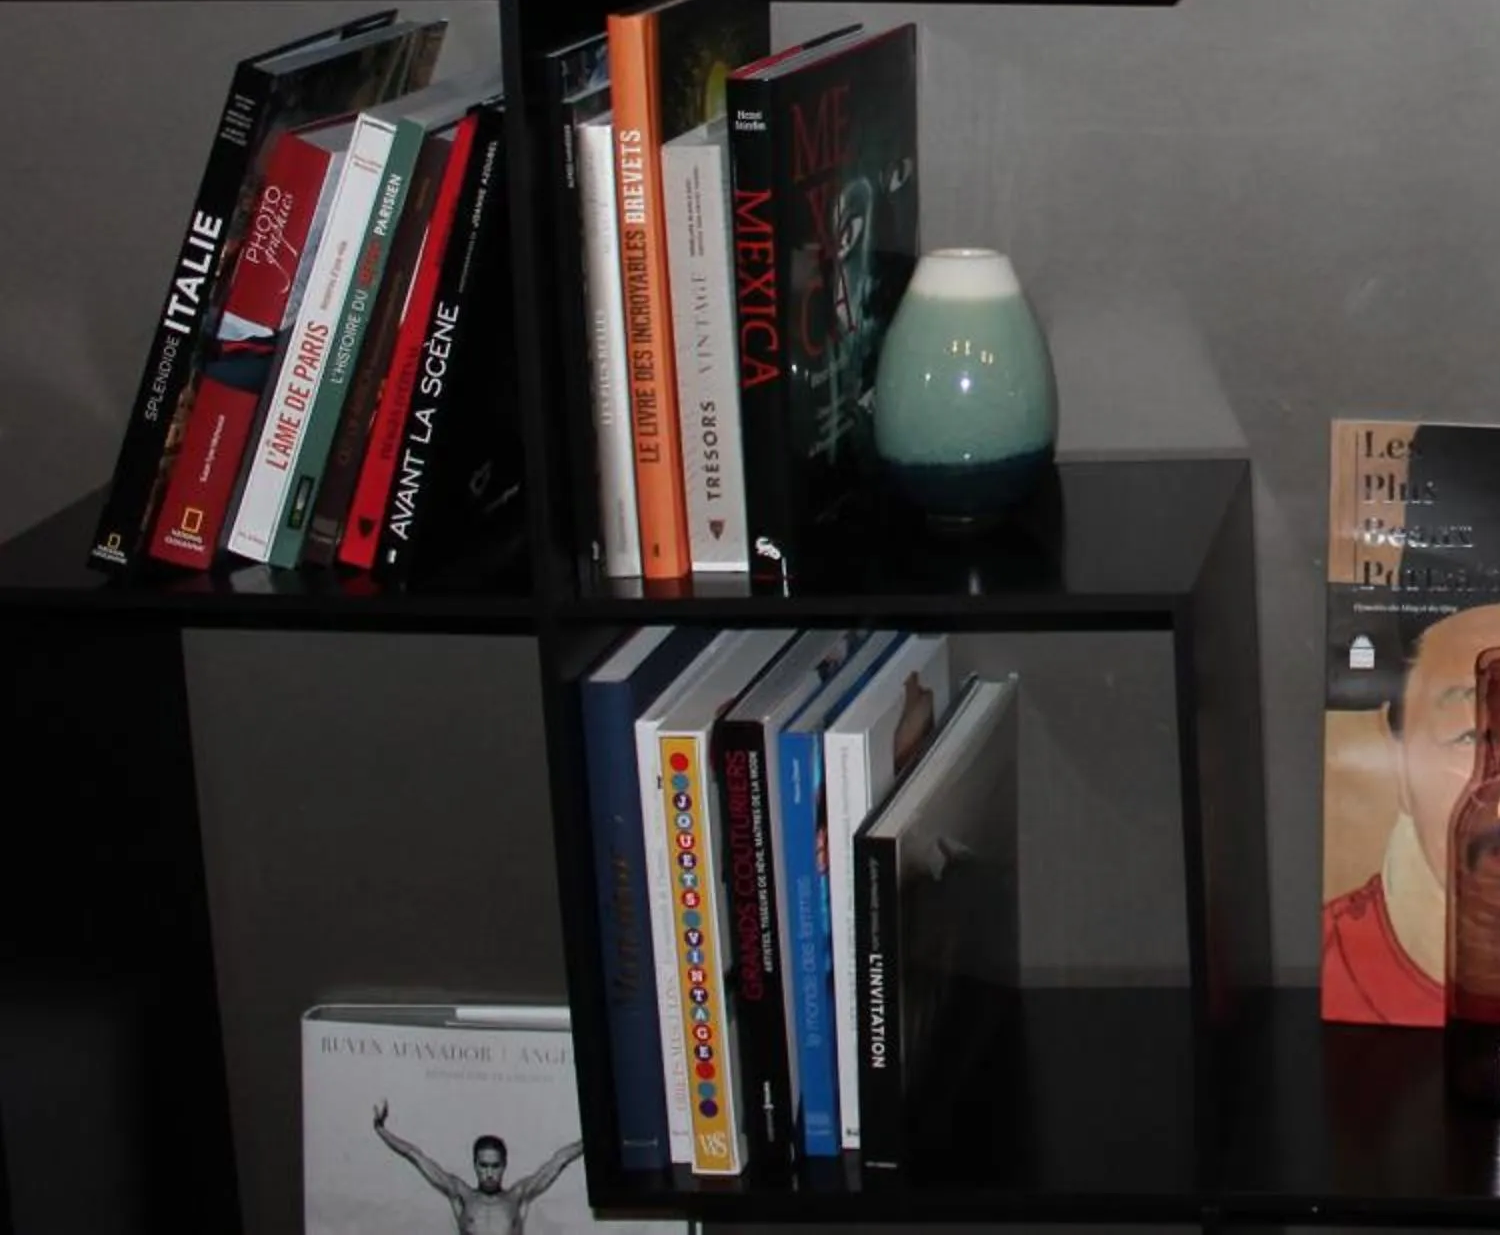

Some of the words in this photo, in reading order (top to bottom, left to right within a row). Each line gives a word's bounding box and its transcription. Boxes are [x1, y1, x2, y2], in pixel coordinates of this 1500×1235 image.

[618, 128, 647, 225] BREVETS
[243, 185, 283, 265] PHOTO
[161, 209, 224, 335] ITALIE
[329, 316, 363, 385] L'HISTOIRE
[348, 288, 369, 312] DU
[371, 172, 403, 237] PARISIEN
[624, 229, 653, 344] INCROYABLES
[732, 187, 782, 391] MEXICA
[143, 333, 182, 421] SPLENDIDE
[291, 320, 330, 378] PARIS
[416, 299, 461, 397] SCÈNE
[632, 349, 656, 382] DES
[282, 380, 310, 413] DE
[408, 406, 436, 444] LA
[636, 388, 660, 437] LIVRE
[262, 413, 302, 473] L'ÂME
[639, 440, 662, 464] LE
[387, 449, 427, 540] AVANT
[724, 749, 756, 895] COUTURIERS
[794, 877, 816, 939] femmes
[732, 901, 763, 1002] GRANDS
[799, 943, 818, 971] des
[802, 976, 821, 1031] monde
[805, 1035, 822, 1047] le
[869, 953, 885, 1069] L'INVITATION
